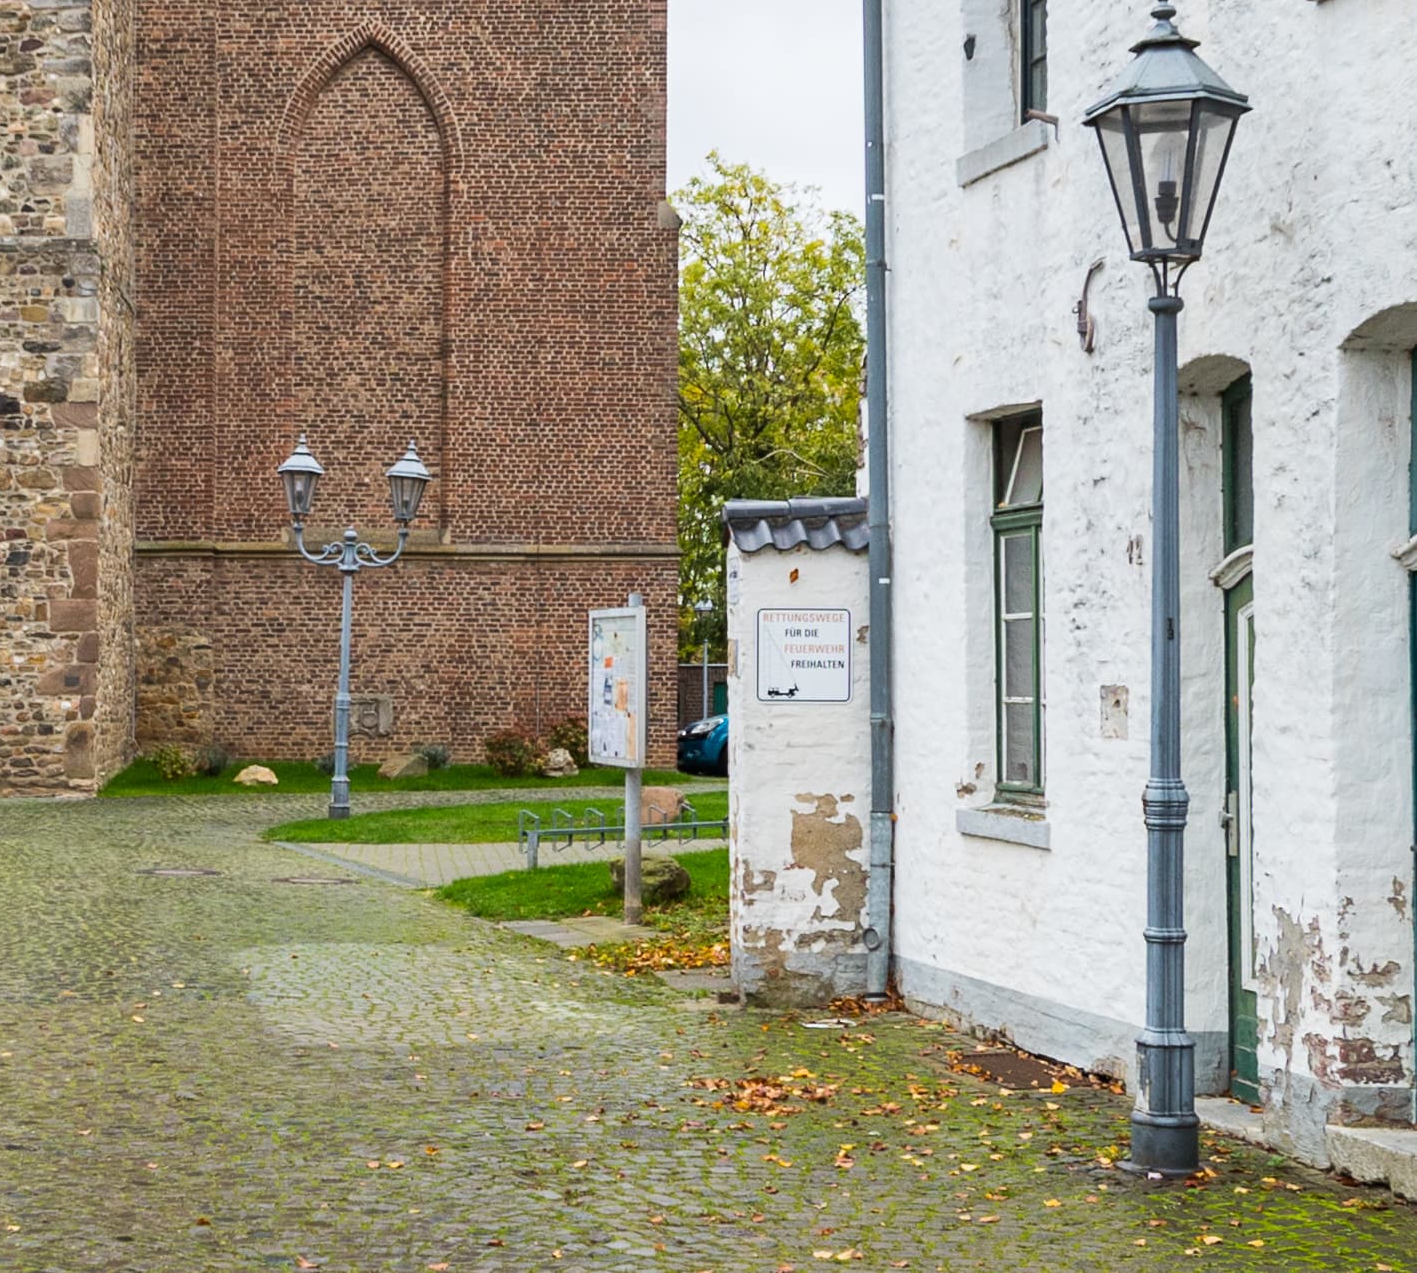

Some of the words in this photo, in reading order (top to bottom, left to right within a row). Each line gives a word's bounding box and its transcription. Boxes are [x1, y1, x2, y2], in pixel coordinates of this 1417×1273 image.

[762, 613, 845, 623] RETTUNGSWEGE
[784, 626, 802, 638] FÜR
[804, 629, 819, 638] DIE
[784, 644, 845, 654] FEUERWEHR
[791, 659, 845, 669] FREIHALTEN
